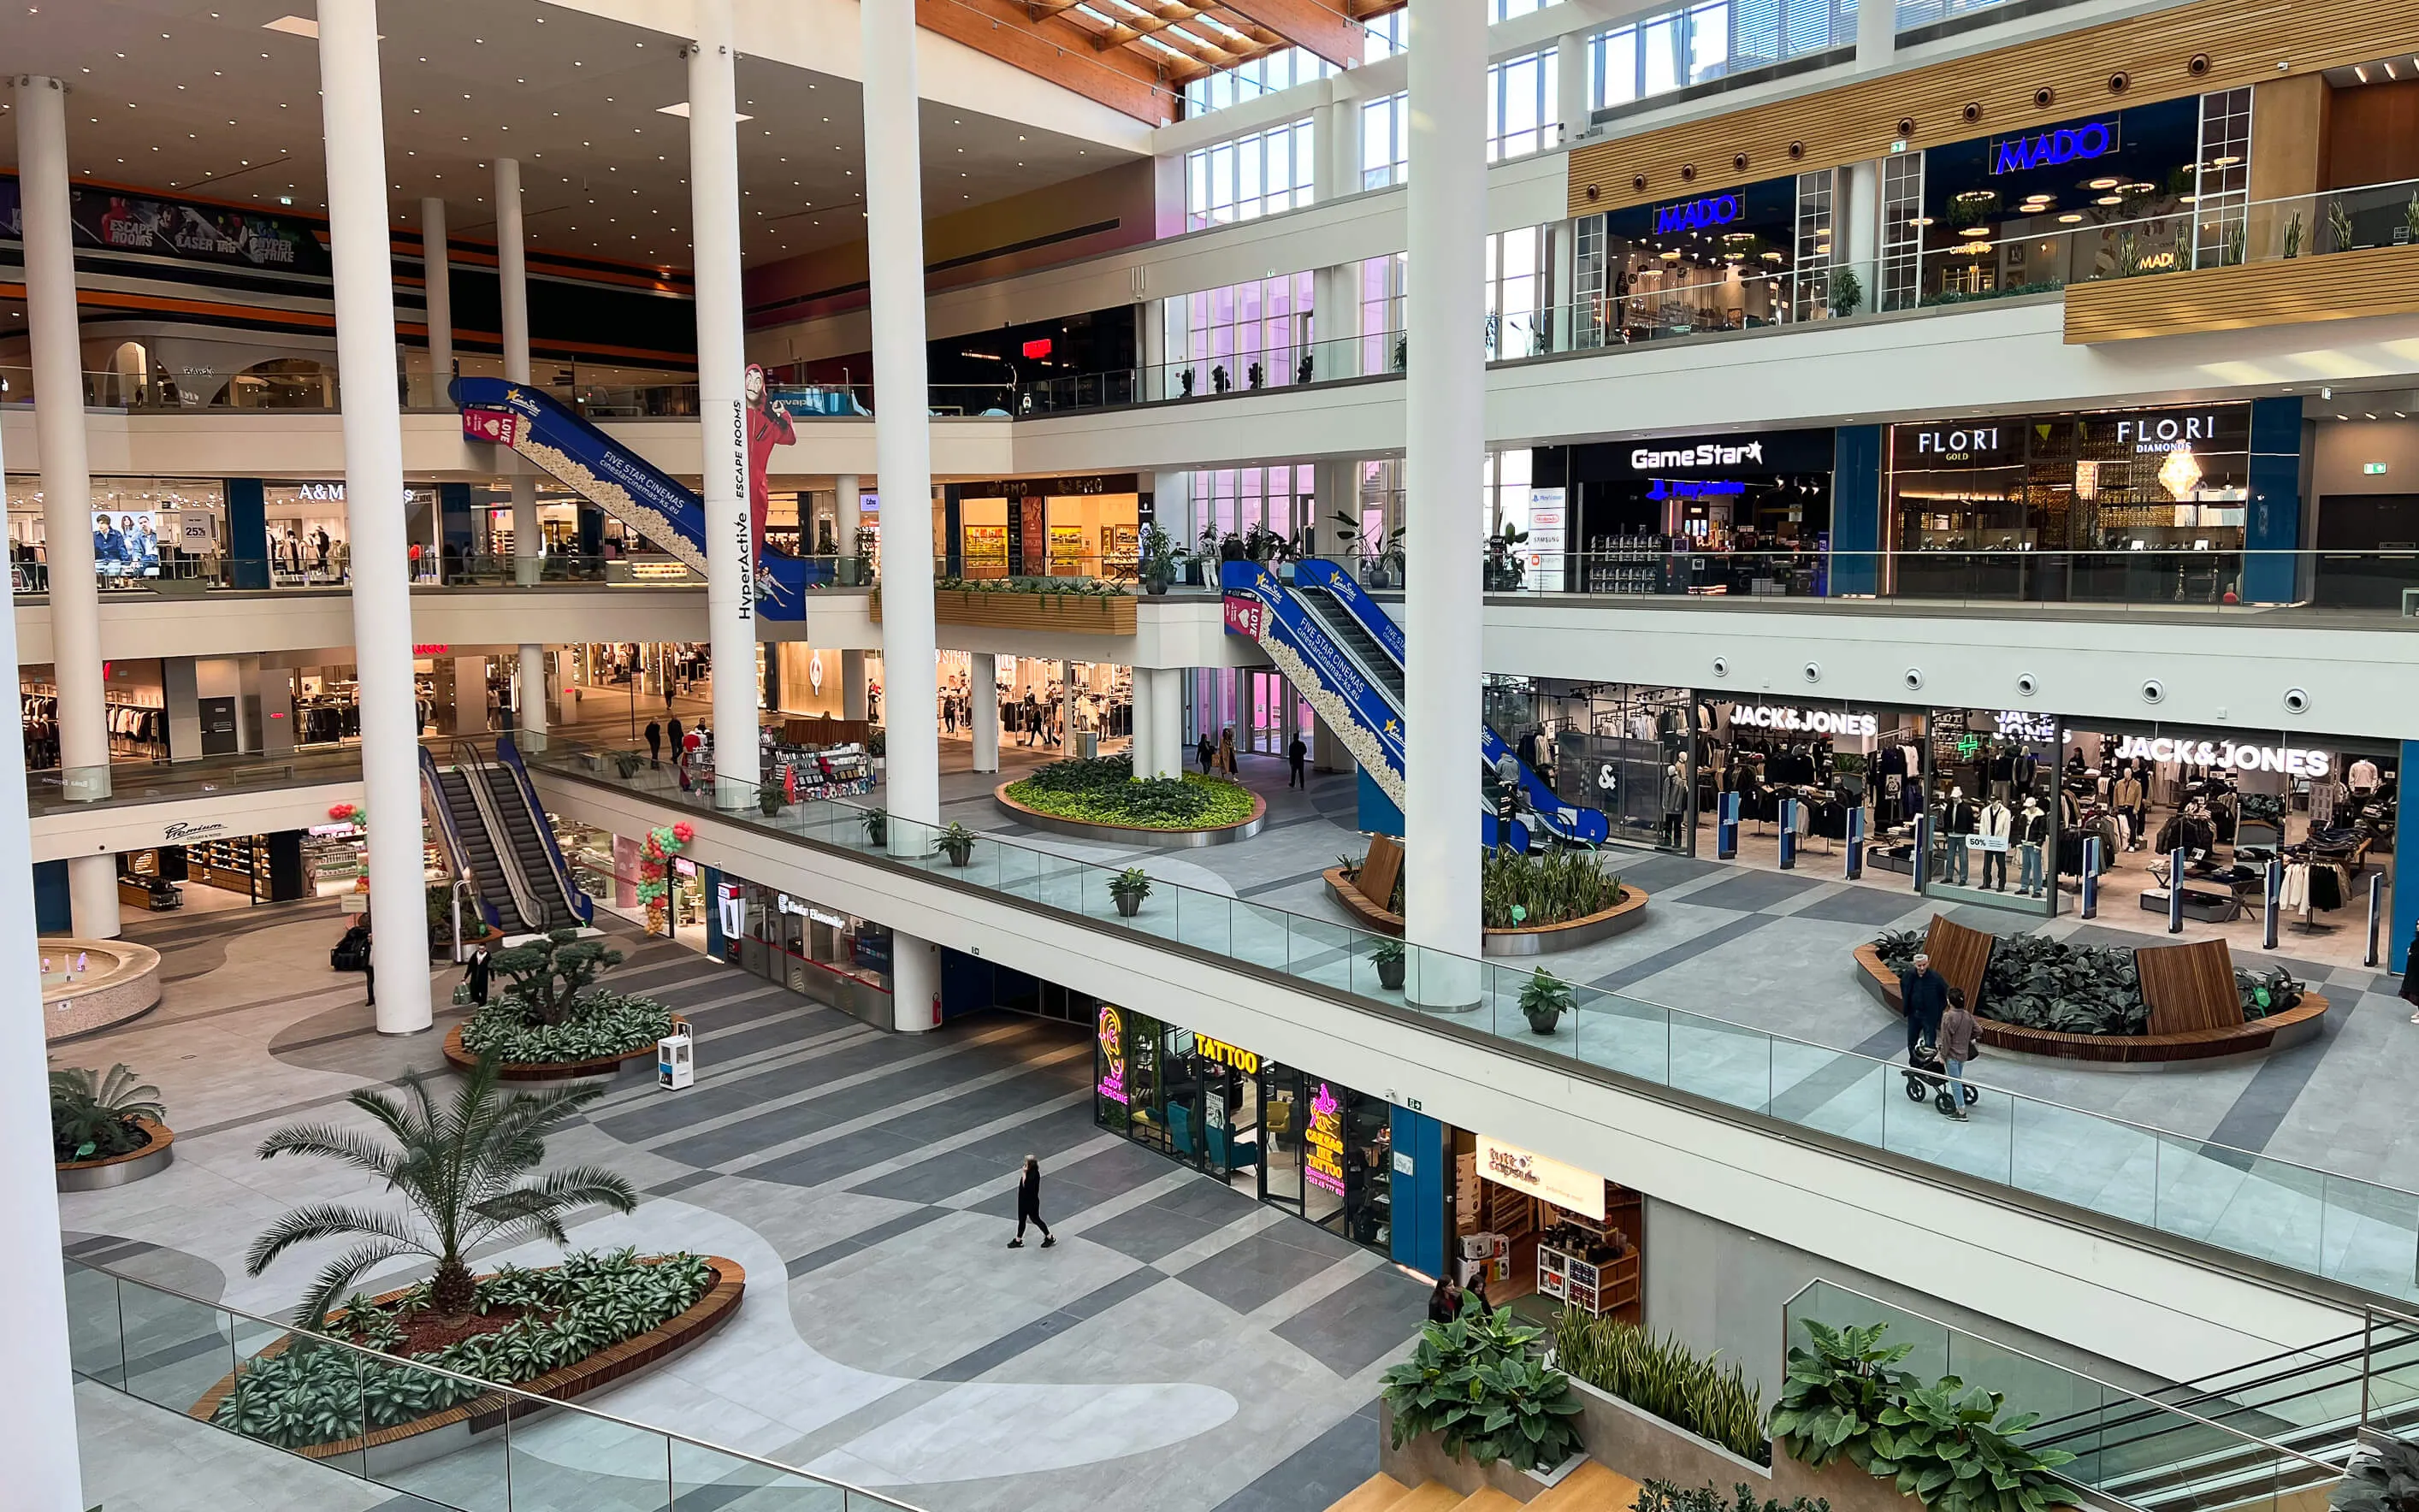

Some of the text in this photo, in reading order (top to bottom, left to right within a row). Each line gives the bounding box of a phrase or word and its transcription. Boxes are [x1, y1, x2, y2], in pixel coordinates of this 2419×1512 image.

[1996, 122, 2109, 174] MADO
[109, 219, 154, 235] ESCAPE
[1657, 194, 1737, 234] MADO
[111, 231, 153, 247] ROOMS
[176, 236, 213, 251] LASER
[500, 418, 513, 444] LOVE
[1919, 428, 1998, 453] FLORI
[2116, 416, 2215, 444] FLORI
[1631, 440, 1759, 470] GameStar
[1945, 452, 1969, 461] GOLD
[2136, 442, 2192, 453] DIAMONDS
[599, 459, 680, 515] cinestarcinemas-ks.eu
[603, 451, 685, 509] FIVE STAR CINEMAS
[733, 399, 751, 621] HyperActive ESCAPE ROOMS
[186, 527, 206, 536] 25%
[1250, 606, 1259, 637] LOVE
[1385, 624, 1399, 640] FIVE
[1297, 627, 1360, 701] cinestarcinemas-ks.eu
[1299, 617, 1365, 694] FIVE STAR CINEMAS
[1730, 703, 1877, 737] JACK&JONES
[2114, 735, 2329, 777] JACK&JONES
[1598, 764, 1617, 790] &
[164, 822, 223, 840] Premium
[1970, 838, 1986, 847] 50%
[1194, 1033, 1257, 1075] TATTOO
[1097, 1084, 1128, 1106] PIERCING
[1103, 1076, 1123, 1091] BODY
[1305, 1128, 1344, 1155] CAESAR
[1306, 1153, 1343, 1179] TATTOO
[1489, 1160, 1541, 1186] capsule
